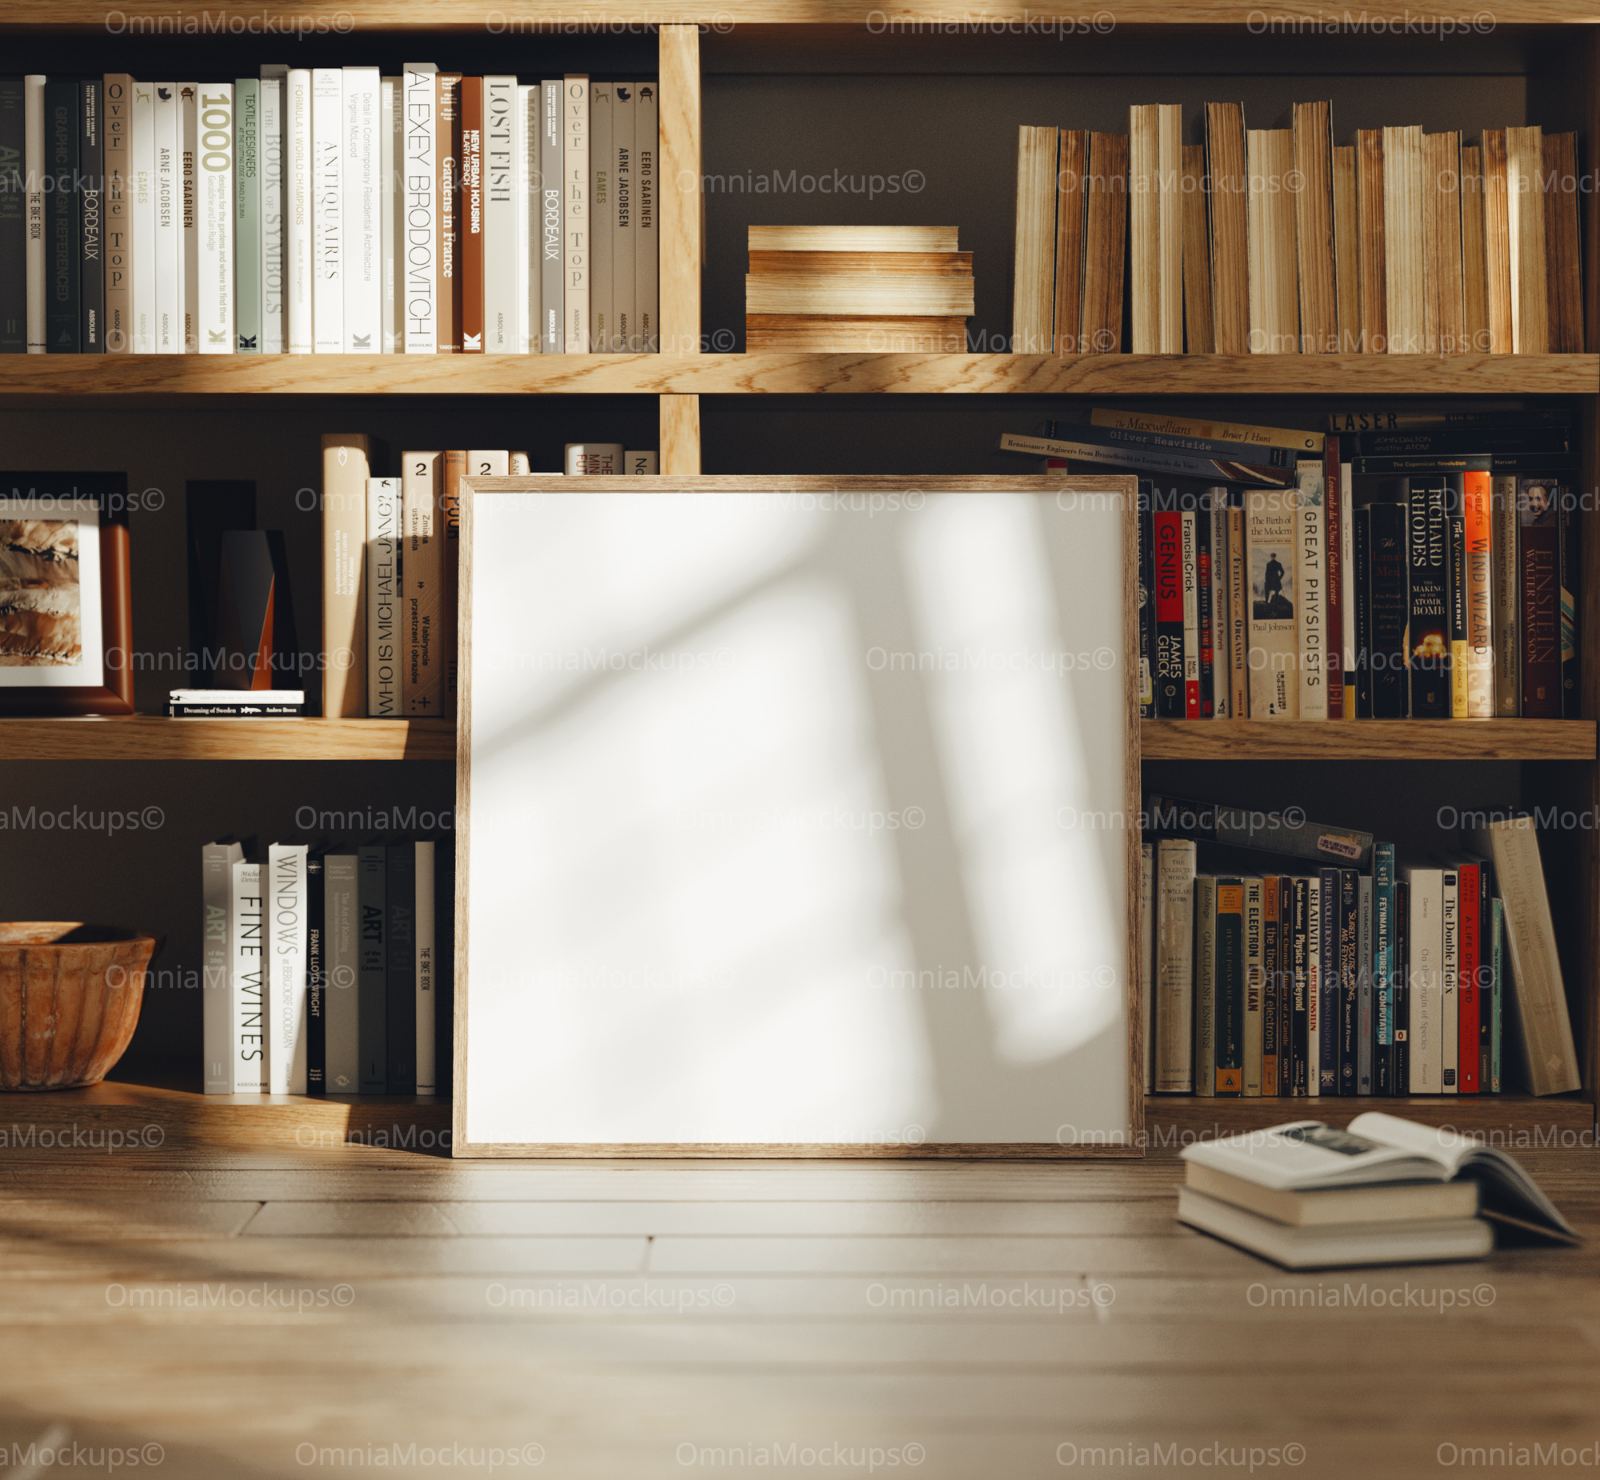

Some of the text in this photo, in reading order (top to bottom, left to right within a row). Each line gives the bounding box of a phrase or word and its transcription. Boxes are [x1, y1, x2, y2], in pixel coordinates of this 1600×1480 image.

[54, 106, 68, 164] GRAPHIC
[201, 93, 231, 172] 1000
[245, 94, 256, 178] TEXTILE DESIGNERS
[349, 94, 359, 157] Virginia McLeod
[363, 93, 372, 116] Detail
[363, 128, 372, 185] Contemporary
[489, 83, 510, 202] LOST FISH
[54, 167, 68, 214] DESIGN
[108, 83, 124, 287] Over the Top
[138, 171, 147, 204] EAMES
[160, 148, 170, 227] ARNE JACOBSEN
[183, 151, 192, 228] EERO SAARINEN
[218, 174, 226, 200] designs
[218, 201, 226, 209] for
[265, 109, 283, 315] THE BOOK OF SYMBOLS
[322, 141, 339, 280] ANTIQUAIRES
[363, 187, 372, 231] Residential
[408, 70, 431, 334] ALEXEY BRODOVITCH
[470, 130, 480, 234] NEW URBAN HOUSING
[569, 83, 584, 287] Over the Top
[597, 171, 606, 204] EAMES
[619, 148, 629, 227] ARNE JACOBSEN
[641, 151, 651, 228] EERO SAARINEN
[30, 192, 40, 240] THE BIKE BOOK
[84, 190, 98, 260] BORDEAUX
[218, 210, 226, 222] the
[218, 223, 226, 249] gardens
[442, 156, 456, 278] Gardens in France
[545, 190, 559, 260] BORDEAUX
[54, 218, 68, 301] REFERENCED
[218, 250, 226, 262] and
[218, 263, 226, 283] where
[363, 234, 372, 282] Architecture
[218, 293, 226, 305] find
[218, 306, 226, 323] them
[1110, 430, 1211, 451] Oliver Heaviside
[1115, 420, 1125, 428] The
[1127, 417, 1191, 435] Maxwellians
[1222, 429, 1242, 441] Bruce
[1251, 432, 1271, 443] Hunt
[1331, 413, 1398, 432] LASER
[415, 463, 427, 475] 2
[1251, 516, 1292, 525] The Birth of
[1251, 527, 1292, 536] the Modern
[1411, 489, 1426, 567] RHODES
[1429, 489, 1443, 567] RICHARD
[1475, 485, 1483, 526] ROBERTS
[1160, 525, 1176, 599] GENIUS
[1184, 519, 1194, 592] Francis Crick
[377, 495, 394, 715] WHO IS MICHAEL JANG?
[410, 598, 418, 643] przestrzeni
[1253, 623, 1295, 633] Paul Johnson
[1304, 511, 1320, 687] GREAT PHYSICISTS
[1413, 605, 1445, 615] BOMB
[1453, 589, 1462, 630] INTERNET
[1472, 538, 1488, 655] WIND WIZARD
[1525, 549, 1537, 663] WALTER ISAACSON
[1535, 550, 1554, 664] EINSTEIN
[1158, 635, 1169, 678] GLEICK
[1170, 635, 1181, 679] JAMES
[206, 905, 226, 944] ART
[276, 854, 298, 955] WINDOWS
[1248, 884, 1259, 957] THE ELECTRON
[1268, 888, 1276, 916] Lorentz
[1310, 888, 1319, 955] RELATIVITY
[310, 929, 319, 1017] FRANK LLOYD WRIGHT
[421, 947, 430, 991] THE BIKE BOOK
[1379, 897, 1387, 1045] FEYNMAN LECTURES ON COMPUTATION
[1445, 898, 1455, 994] The Double Helix
[240, 897, 263, 1061] FINE WINES
[282, 966, 293, 1048] BERGDORF GOODMAN
[1248, 963, 1259, 1012] MILLIKAN
[1265, 927, 1276, 1050] the theory of electrons
